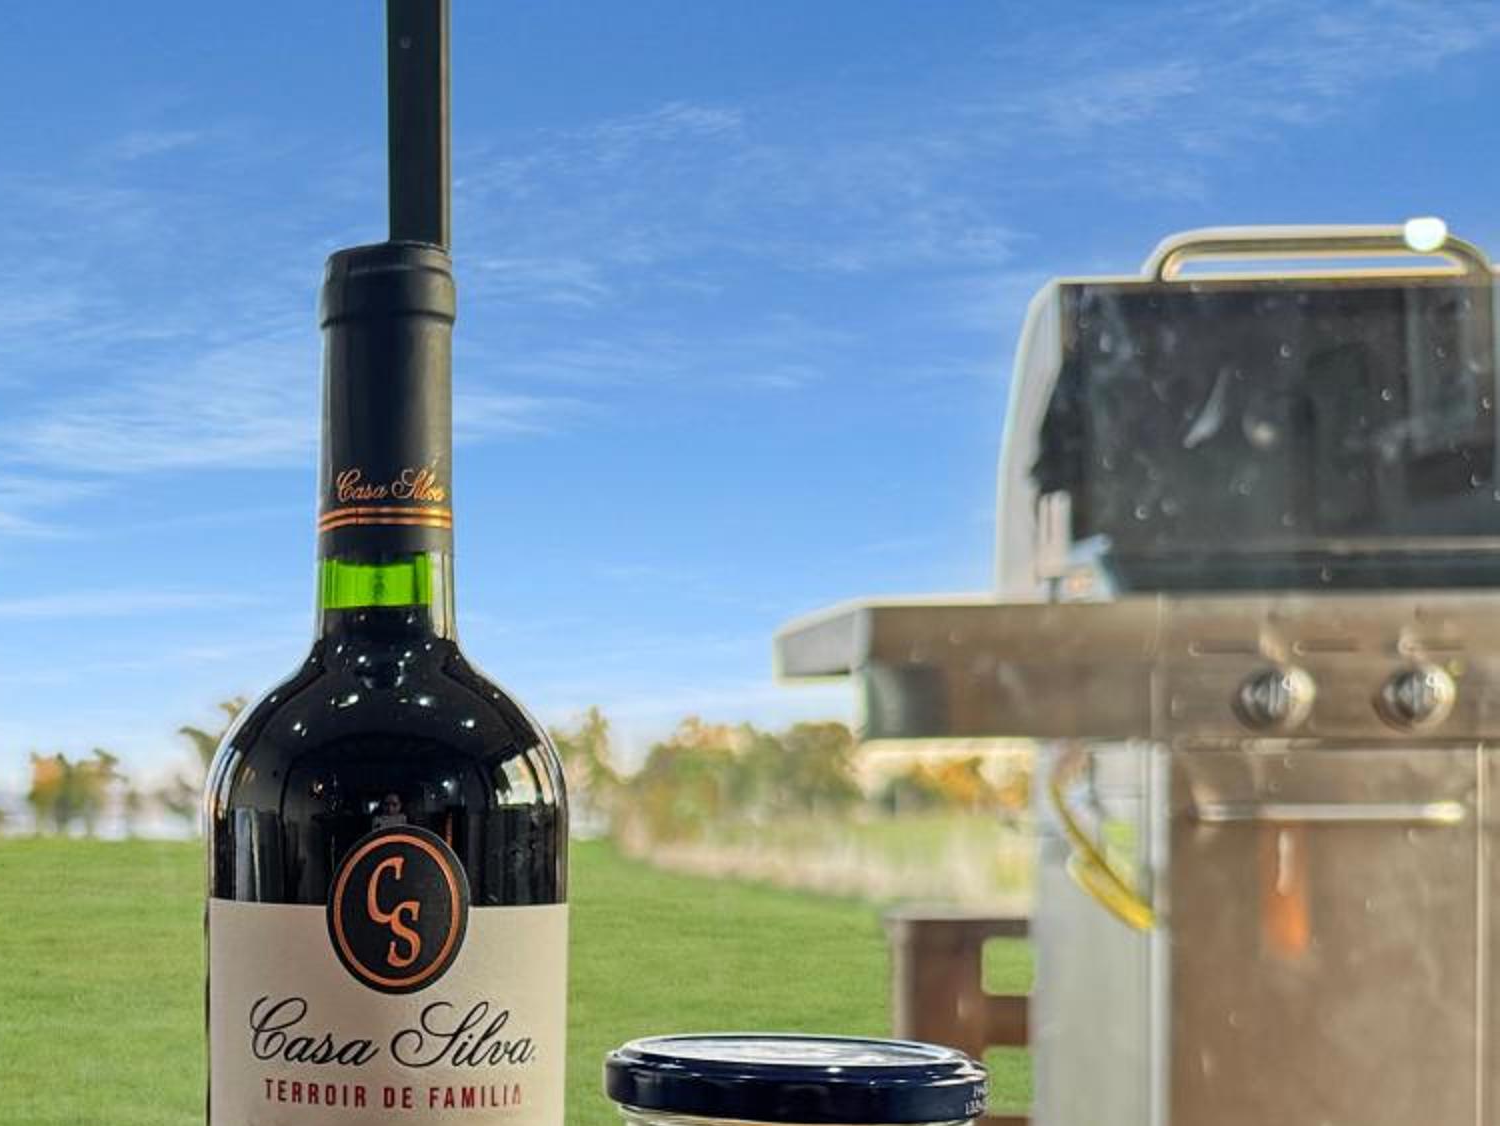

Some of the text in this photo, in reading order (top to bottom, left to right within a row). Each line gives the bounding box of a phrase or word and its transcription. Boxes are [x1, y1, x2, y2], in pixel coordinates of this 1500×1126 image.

[337, 468, 388, 502] Casa
[249, 997, 534, 1068] Casa Silva
[265, 1078, 523, 1110] TERROIR DE FAMILIA
